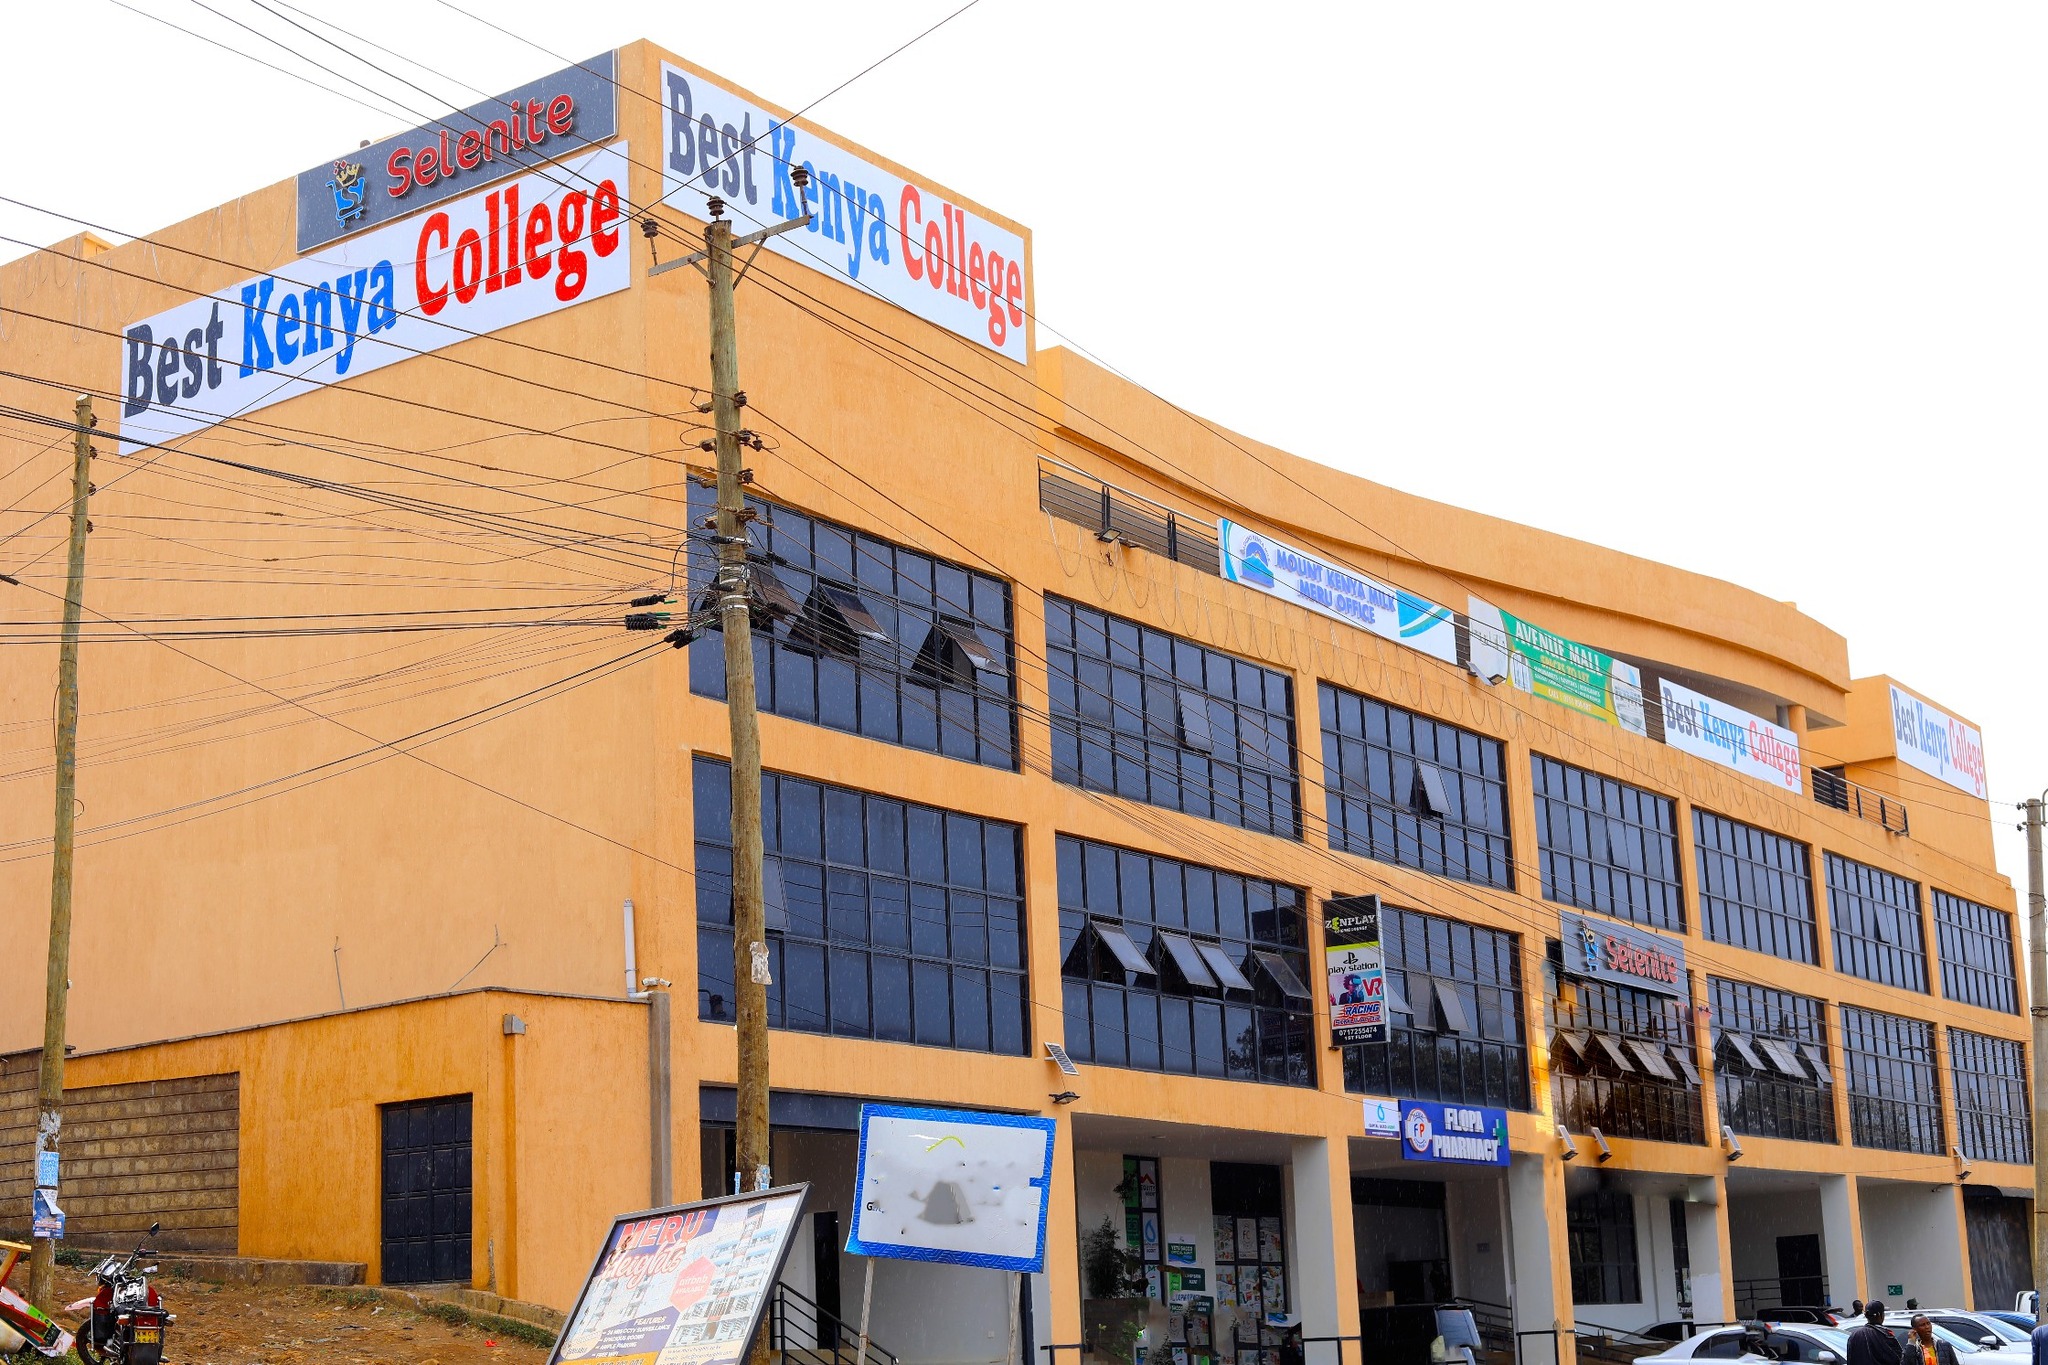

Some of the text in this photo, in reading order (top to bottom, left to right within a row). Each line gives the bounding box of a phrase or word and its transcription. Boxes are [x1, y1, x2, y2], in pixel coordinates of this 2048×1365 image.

[386, 93, 574, 198] Selenite
[667, 70, 1023, 347] Best Kenya College
[124, 179, 621, 419] Best Kenya College
[1275, 549, 1396, 612] MOUNT KENYA MILK
[1299, 580, 1376, 624] MERU OFFICE
[1516, 620, 1565, 657] AVENUE
[1569, 643, 1603, 677] MALL
[1663, 686, 1699, 738] Best
[1699, 701, 1747, 764] Kenya
[1749, 720, 1799, 786] College
[1892, 688, 1984, 796] Best Kenya College
[1325, 914, 1376, 931] ZENPLAY
[1328, 962, 1378, 976] play station
[1605, 934, 1679, 984] Selenite
[1345, 1003, 1380, 1016] RACING
[1362, 977, 1383, 997] VR
[1444, 1107, 1484, 1133] FLOPA
[1433, 1135, 1499, 1161] PHARMACY
[617, 1210, 707, 1249] MERU
[601, 1240, 689, 1290] Heights
